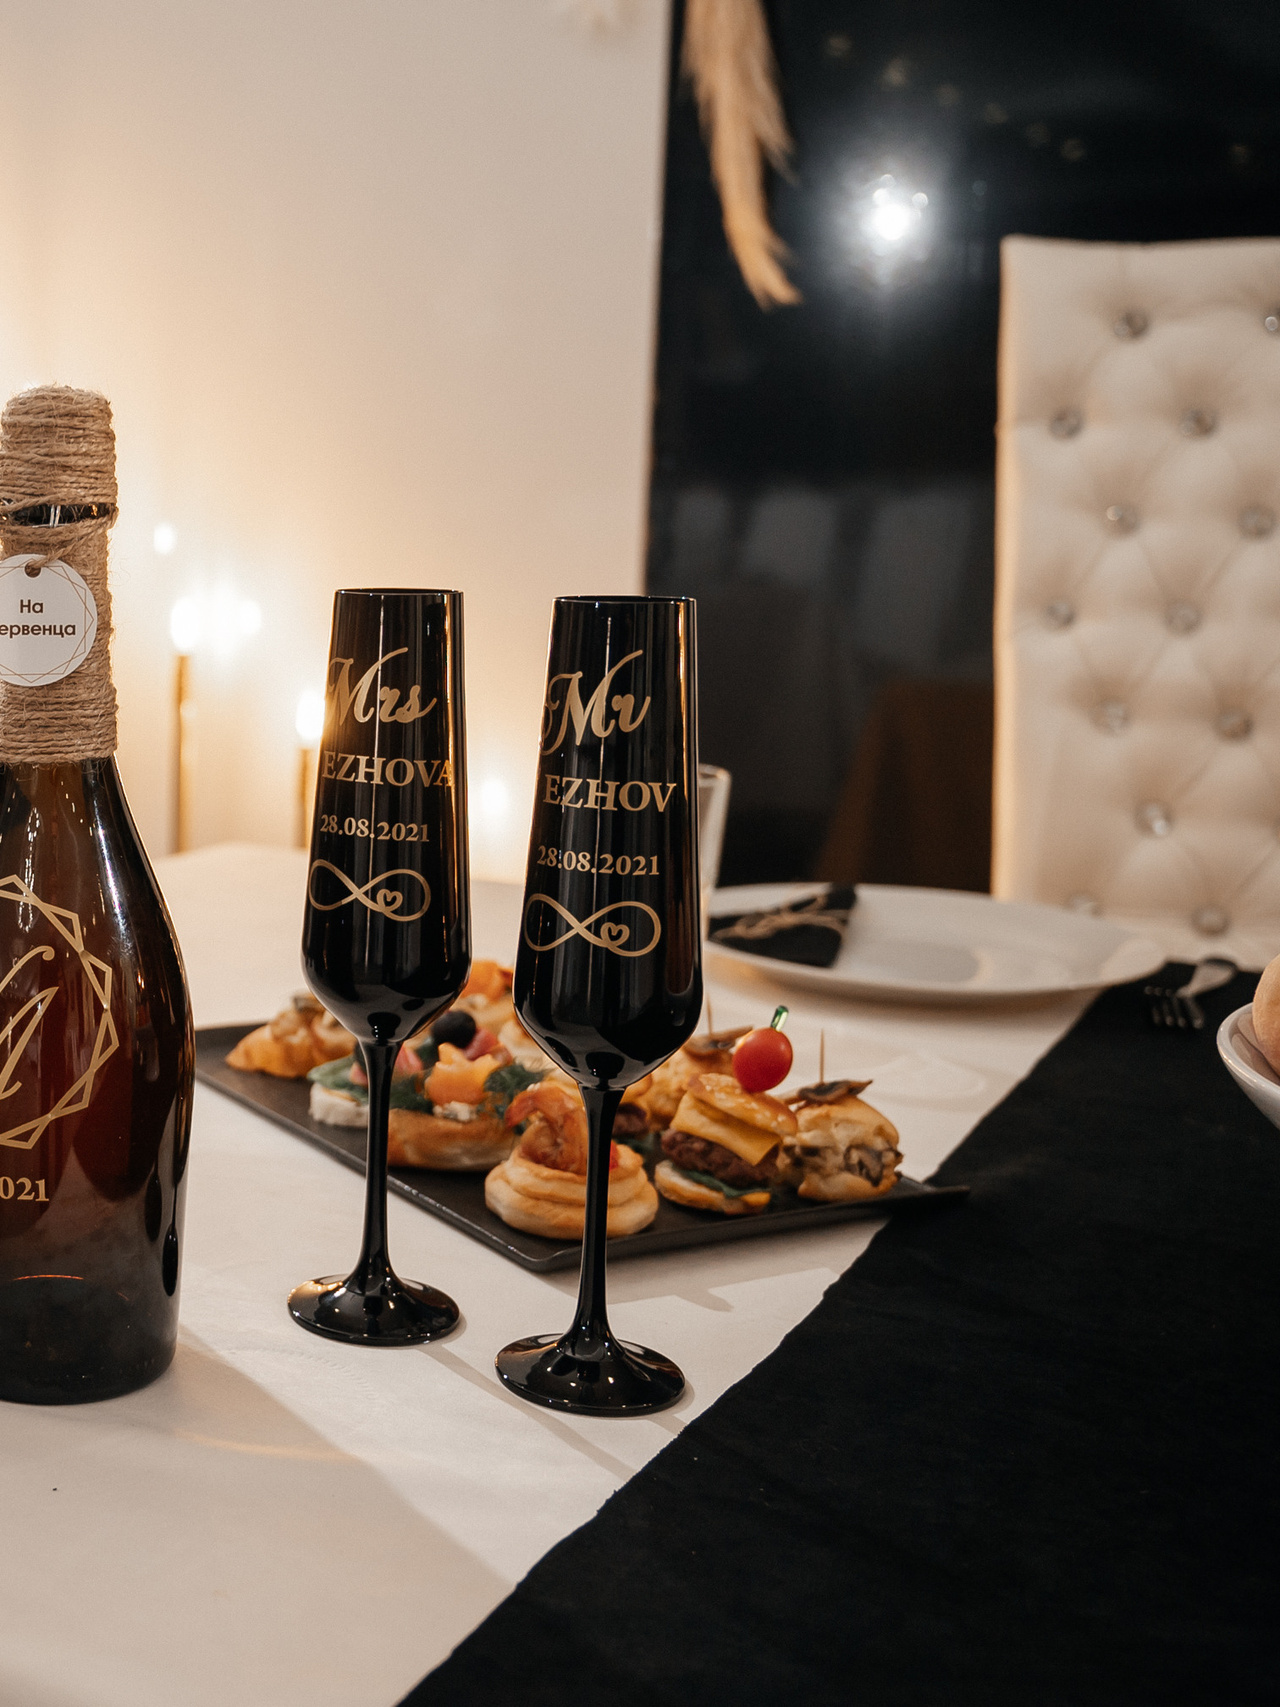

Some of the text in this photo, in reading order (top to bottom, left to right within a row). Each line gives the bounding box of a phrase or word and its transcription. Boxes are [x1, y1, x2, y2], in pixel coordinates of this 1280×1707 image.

[19, 599, 44, 614] На
[326, 646, 438, 727] Mrs
[540, 649, 651, 756] Mr
[322, 750, 455, 788] EZHOVA
[542, 774, 677, 813] EZHOV
[320, 814, 430, 842] 28.08.2021
[536, 845, 660, 876] 28.08.2021
